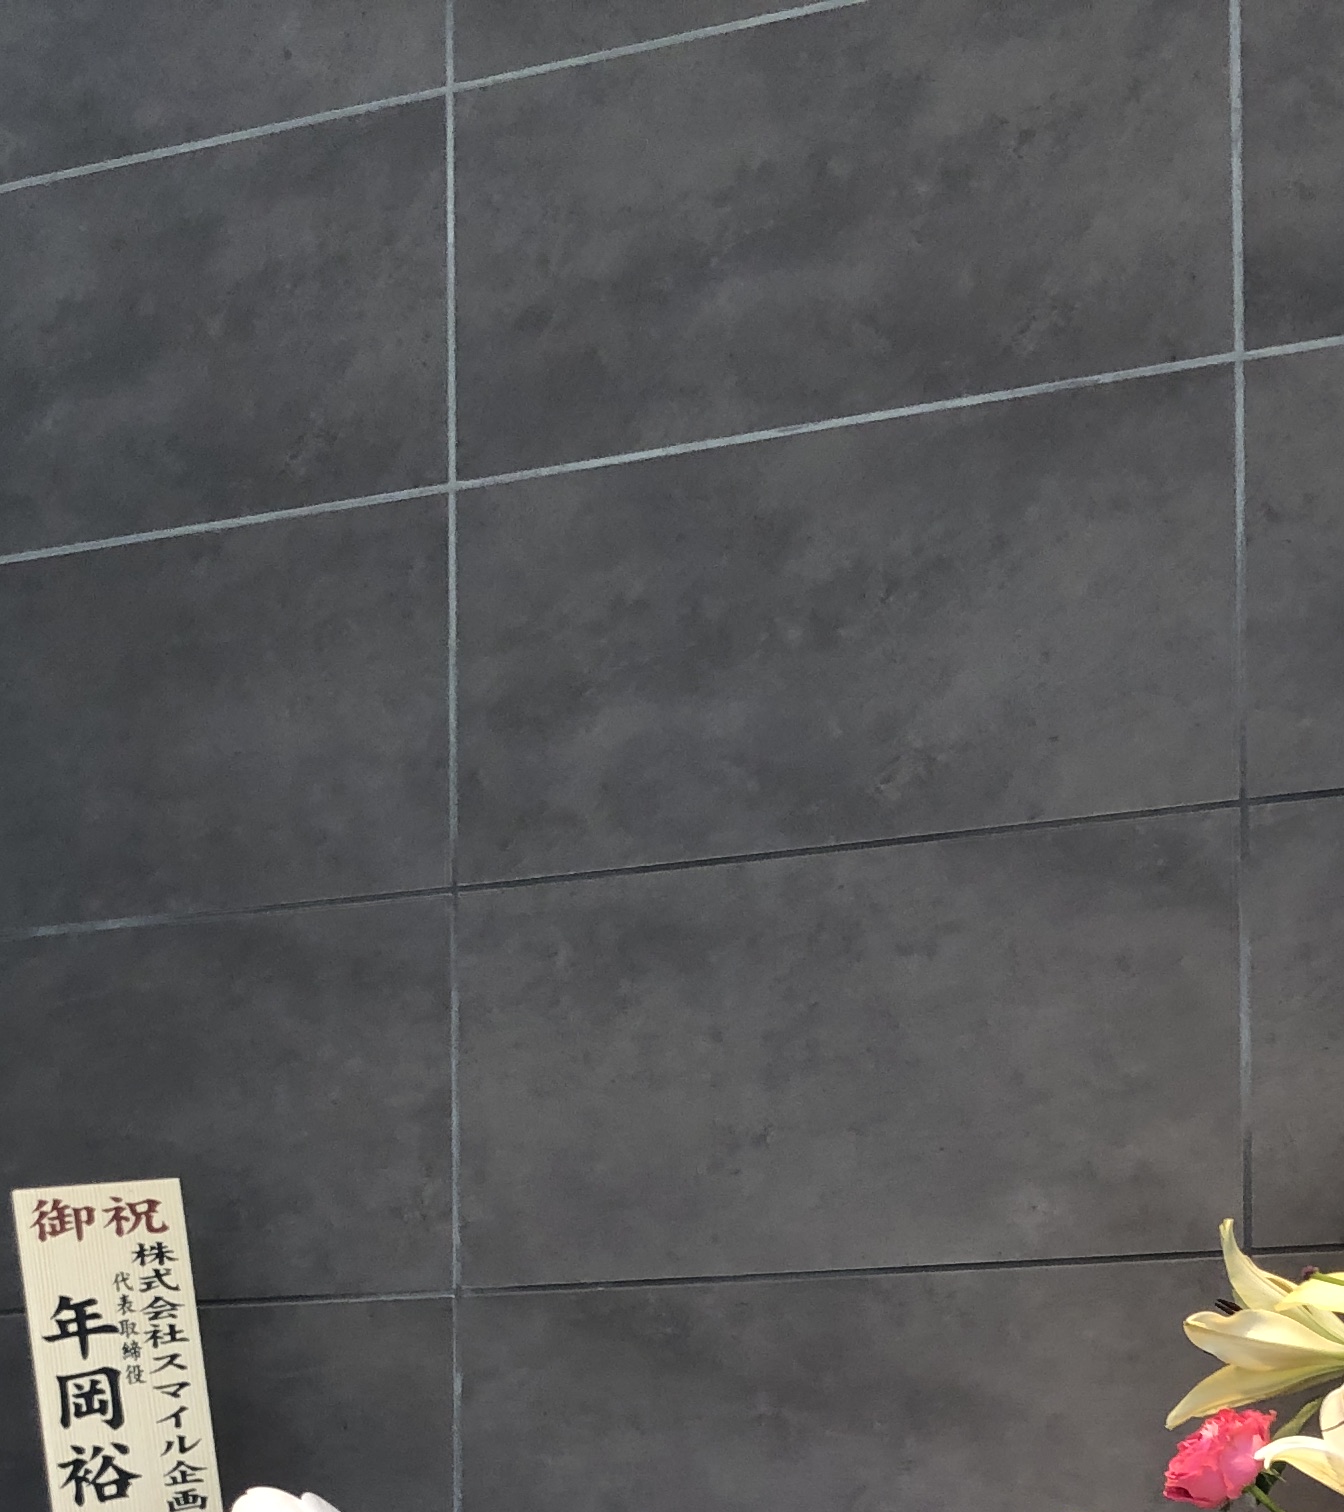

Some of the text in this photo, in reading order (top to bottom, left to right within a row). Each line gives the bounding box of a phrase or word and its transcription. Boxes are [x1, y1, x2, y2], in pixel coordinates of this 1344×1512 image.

[30, 1196, 171, 1243] 御祝
[112, 1270, 148, 1385] 代表取締役
